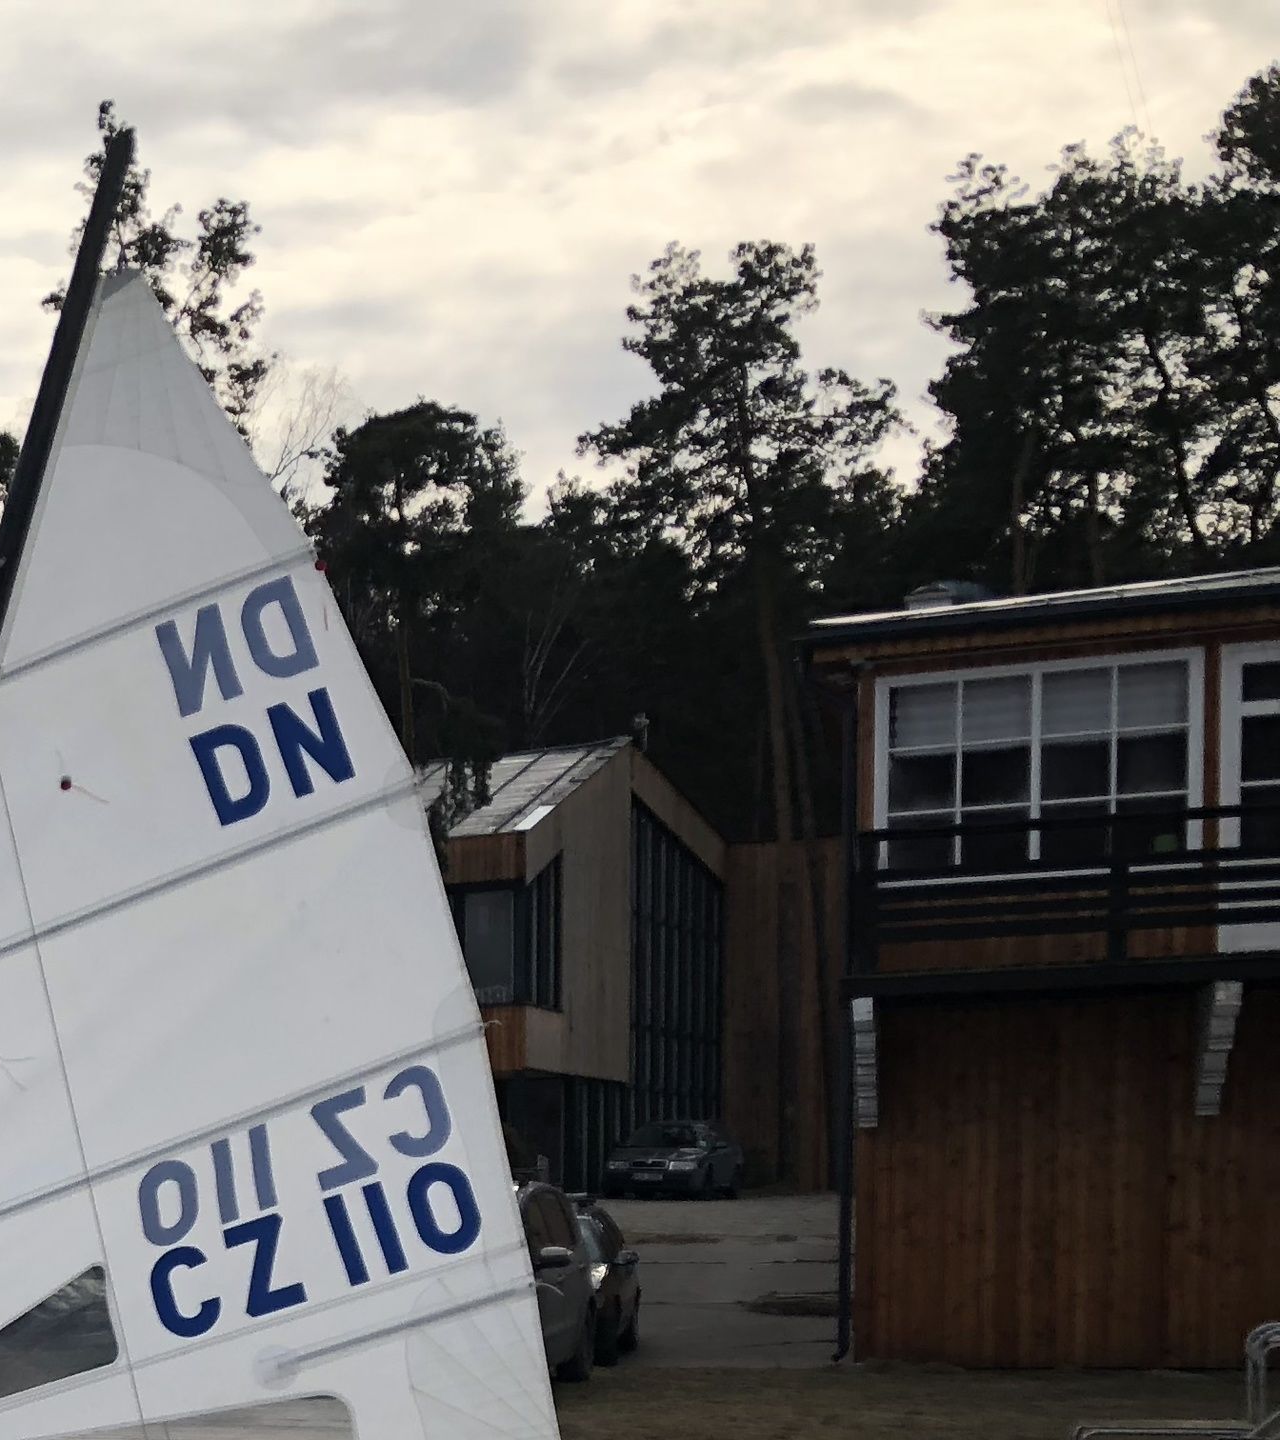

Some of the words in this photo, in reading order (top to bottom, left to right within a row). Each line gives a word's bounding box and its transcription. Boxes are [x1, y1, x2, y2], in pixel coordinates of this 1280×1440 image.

[189, 686, 356, 827] DN
[150, 1212, 308, 1338] CZ
[322, 1162, 482, 1288] 110
